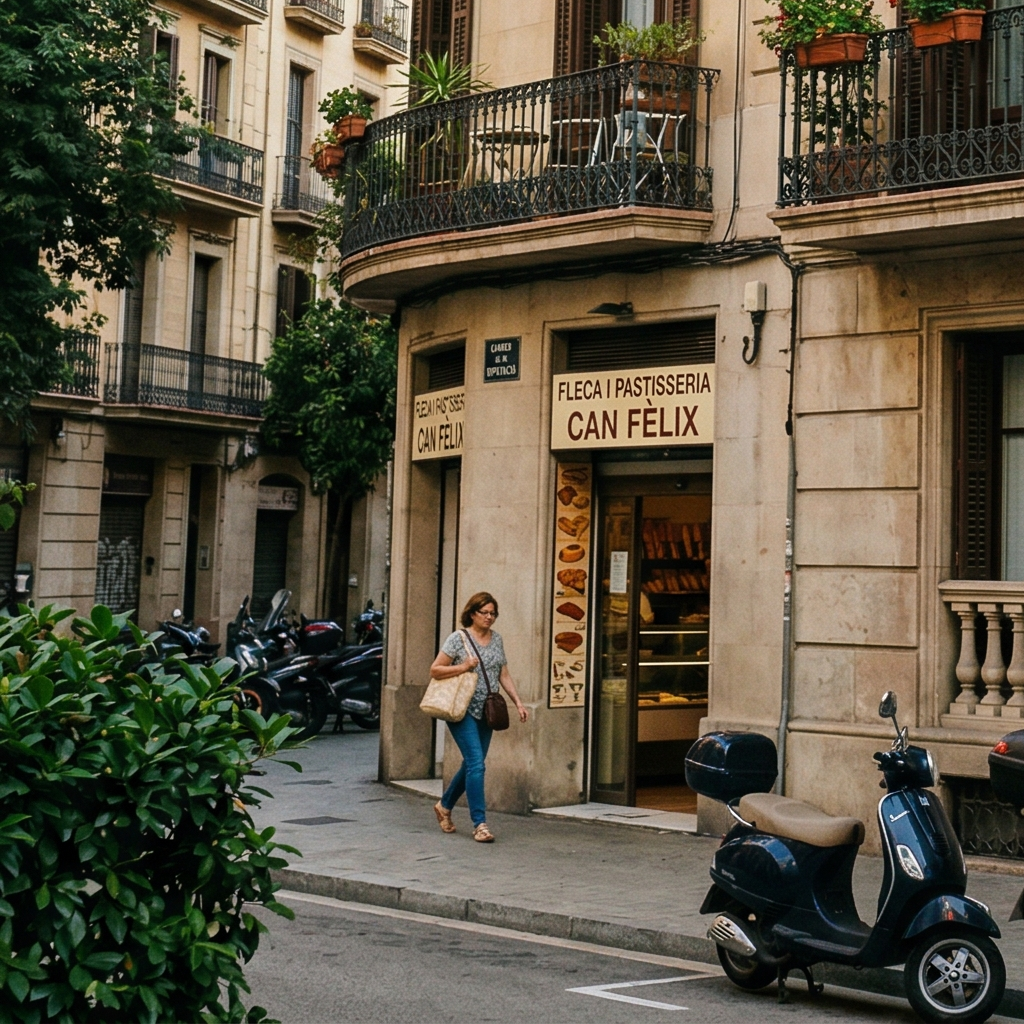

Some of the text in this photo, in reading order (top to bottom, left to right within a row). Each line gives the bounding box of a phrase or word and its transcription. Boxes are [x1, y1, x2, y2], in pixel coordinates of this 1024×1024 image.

[558, 372, 711, 401] FLECA I PASTISSERIA
[418, 415, 465, 453] CAN FÈLIX
[567, 398, 699, 441] CAN FÈLIX
